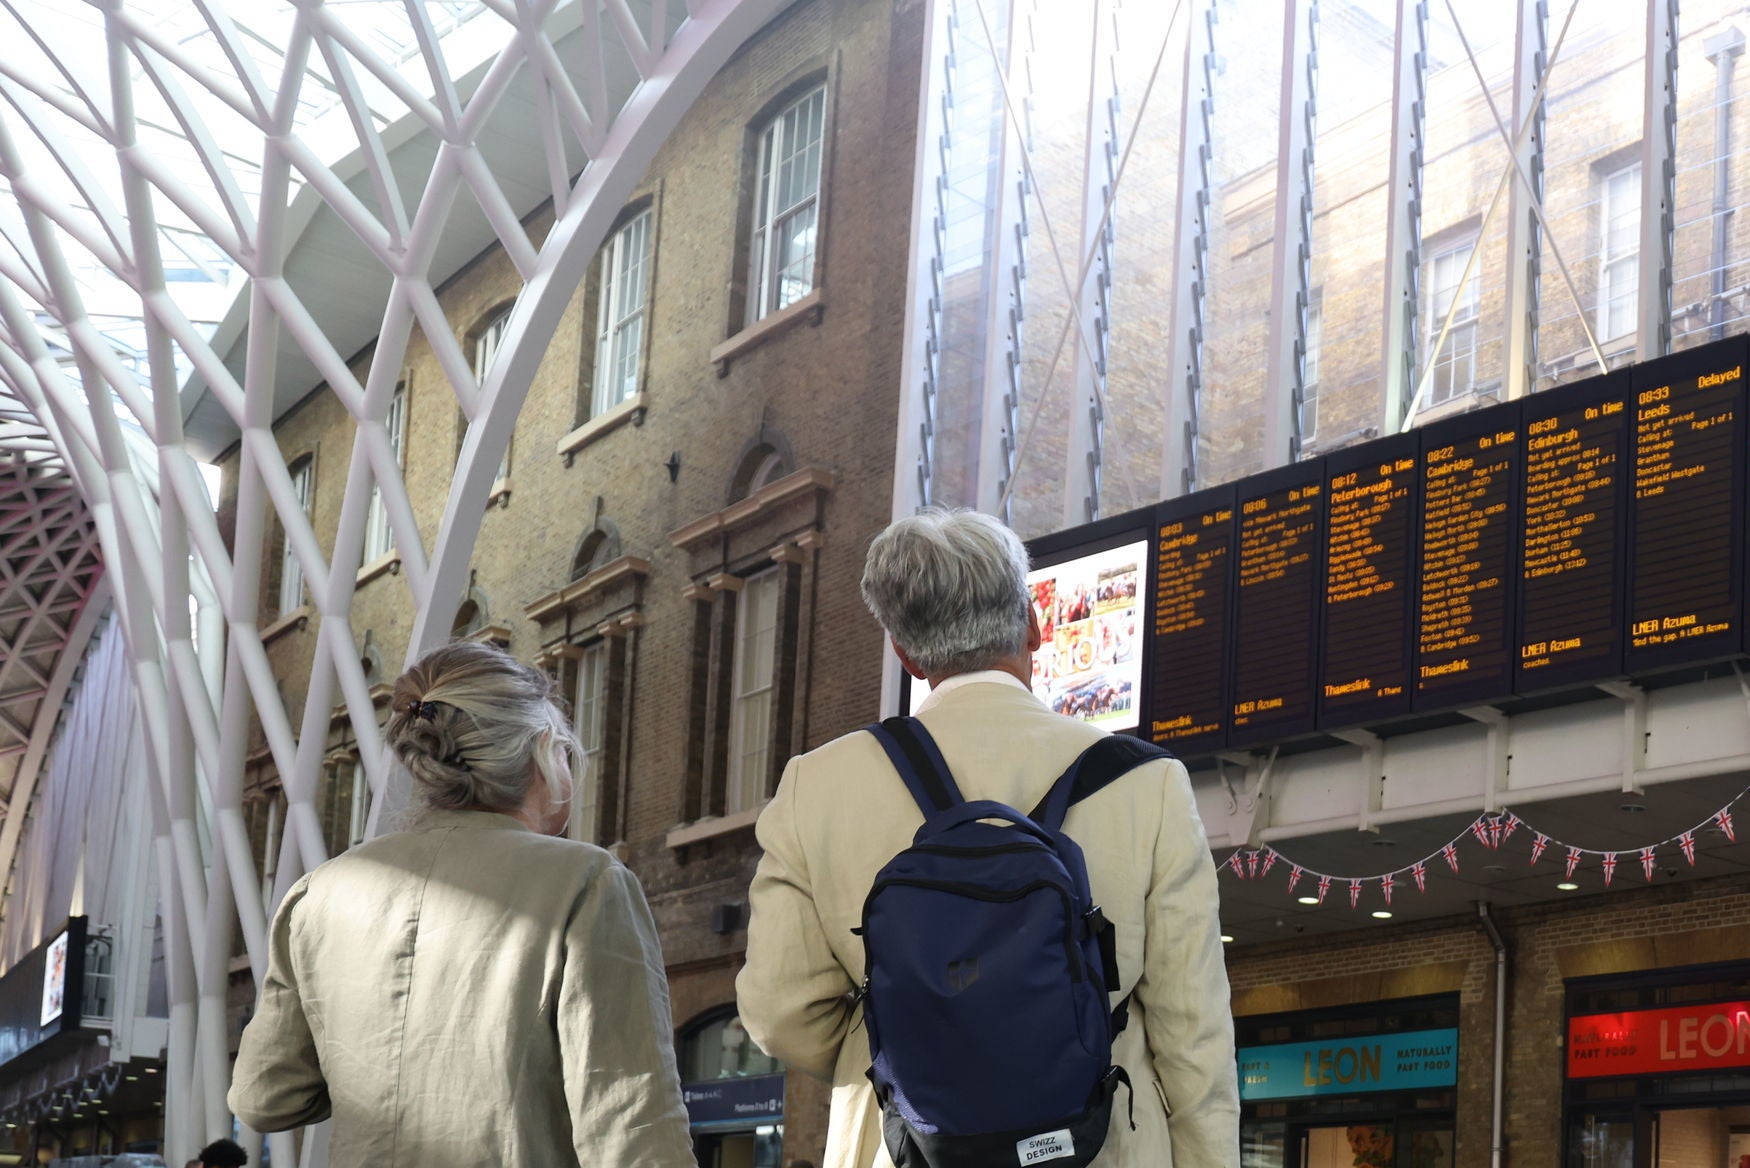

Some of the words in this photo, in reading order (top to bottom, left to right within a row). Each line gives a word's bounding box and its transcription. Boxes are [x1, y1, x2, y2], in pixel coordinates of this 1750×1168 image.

[1637, 384, 1671, 406] 08:33
[1695, 365, 1742, 389] Delayed
[1527, 416, 1559, 436] 08:30
[1583, 406, 1601, 420] On
[1599, 400, 1625, 416] time
[1636, 402, 1672, 422] Leeds
[1526, 427, 1580, 451] Edinburgh
[1632, 619, 1659, 636] LNER
[1662, 613, 1697, 631] Azuma
[1520, 640, 1549, 659] LNER
[1546, 636, 1583, 653] Azuma
[1397, 1045, 1453, 1059] NATURALLY
[1574, 1047, 1600, 1060] FAST
[1605, 1045, 1637, 1058] FOOD
[1303, 1044, 1383, 1088] LEON
[1397, 1061, 1420, 1073] FAST
[1423, 1060, 1451, 1072] FOOD
[1026, 1144, 1063, 1161] DESIGN
[1029, 1136, 1056, 1149] SWIZZ
